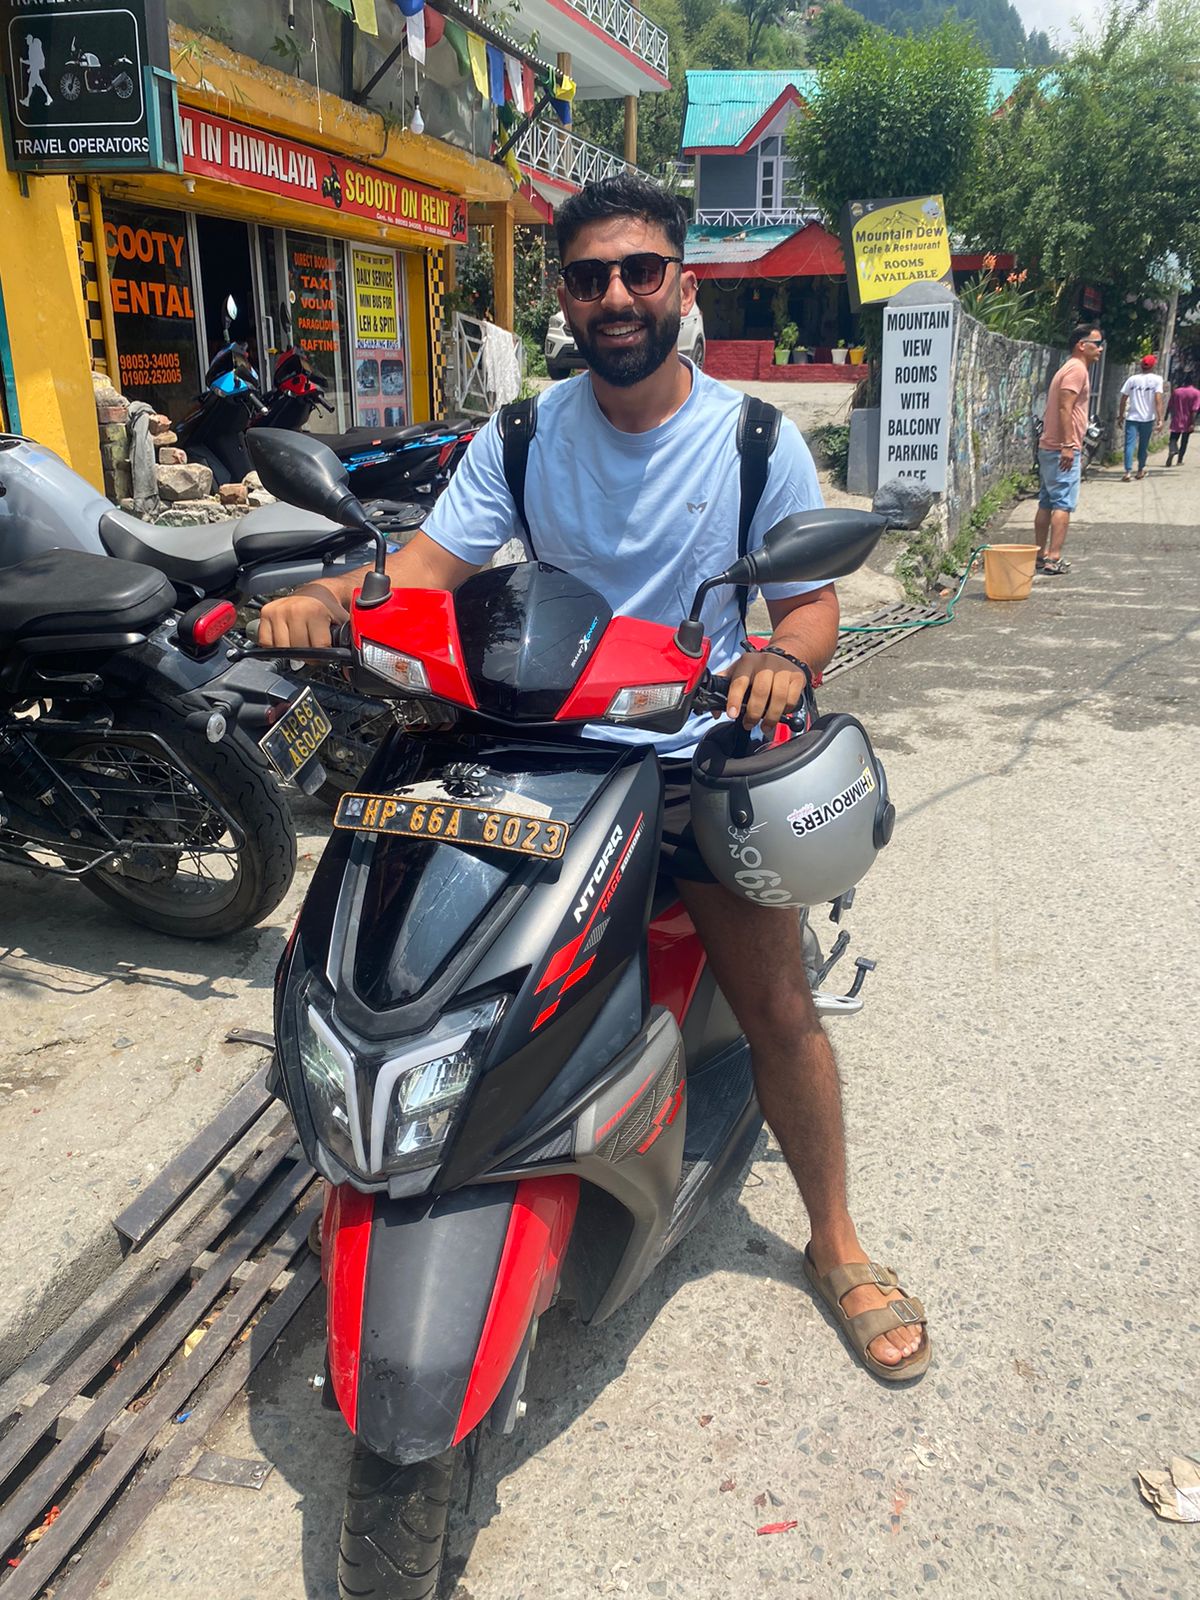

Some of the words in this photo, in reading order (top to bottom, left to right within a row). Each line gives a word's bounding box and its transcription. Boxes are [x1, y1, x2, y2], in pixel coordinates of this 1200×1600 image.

[16, 138, 66, 154] TRAVEL
[68, 136, 149, 154] OPERATORS
[200, 122, 222, 164] IN
[229, 131, 318, 190] HIMALAYA
[345, 168, 397, 213] SCOOTY
[401, 187, 418, 219] ON
[421, 193, 450, 228] RENT
[855, 227, 913, 243] Mountain
[916, 226, 944, 238] Dew
[862, 244, 882, 254] Cafe
[884, 244, 890, 253] &
[893, 241, 940, 253] Restaurant
[884, 258, 924, 269] ROOMS
[301, 275, 334, 291] TAXI
[357, 268, 371, 286] DAILY
[372, 270, 393, 288] SERVICE
[873, 269, 938, 283] AVAILABLE
[301, 297, 335, 311] VOLVO
[359, 294, 371, 308] MINI
[372, 295, 382, 309] BUS
[383, 297, 392, 309] FOR
[359, 315, 372, 332] LEH
[373, 315, 379, 333] &
[379, 316, 395, 333] SPITI
[887, 311, 949, 331] MOUNTAIN
[300, 339, 339, 352] RAFTING
[902, 339, 932, 357] VIEW
[120, 353, 180, 369] 98053-34005
[122, 370, 182, 385] 01902-252005
[895, 365, 937, 384] ROOMS
[901, 392, 929, 410] WITH
[888, 417, 941, 436] BALCONY
[888, 444, 938, 462] PARKING
[279, 701, 314, 744] HP66
[288, 716, 327, 768] A6040
[362, 799, 398, 828] HP
[409, 804, 462, 837] 66A
[483, 813, 561, 853] 6023
[573, 824, 623, 923] NTORQ
[601, 870, 622, 913] RACE
